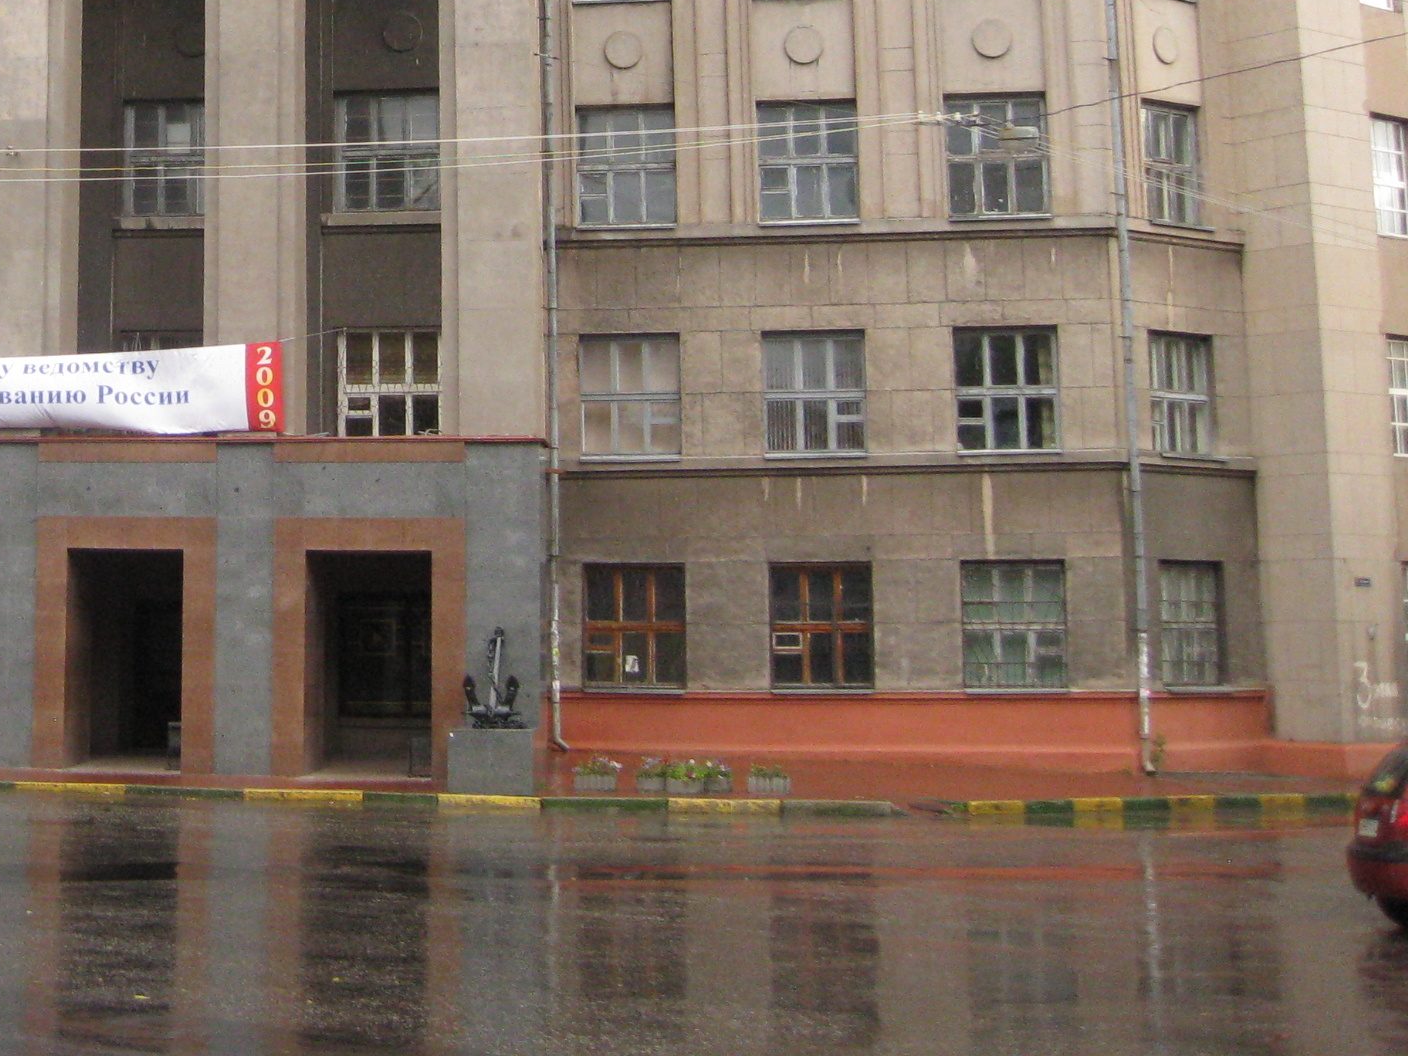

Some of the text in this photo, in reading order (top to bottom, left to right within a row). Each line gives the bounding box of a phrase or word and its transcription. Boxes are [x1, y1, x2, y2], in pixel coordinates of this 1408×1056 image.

[22, 359, 160, 380] ведомству
[96, 384, 191, 406] России
[255, 346, 276, 429] 2009
